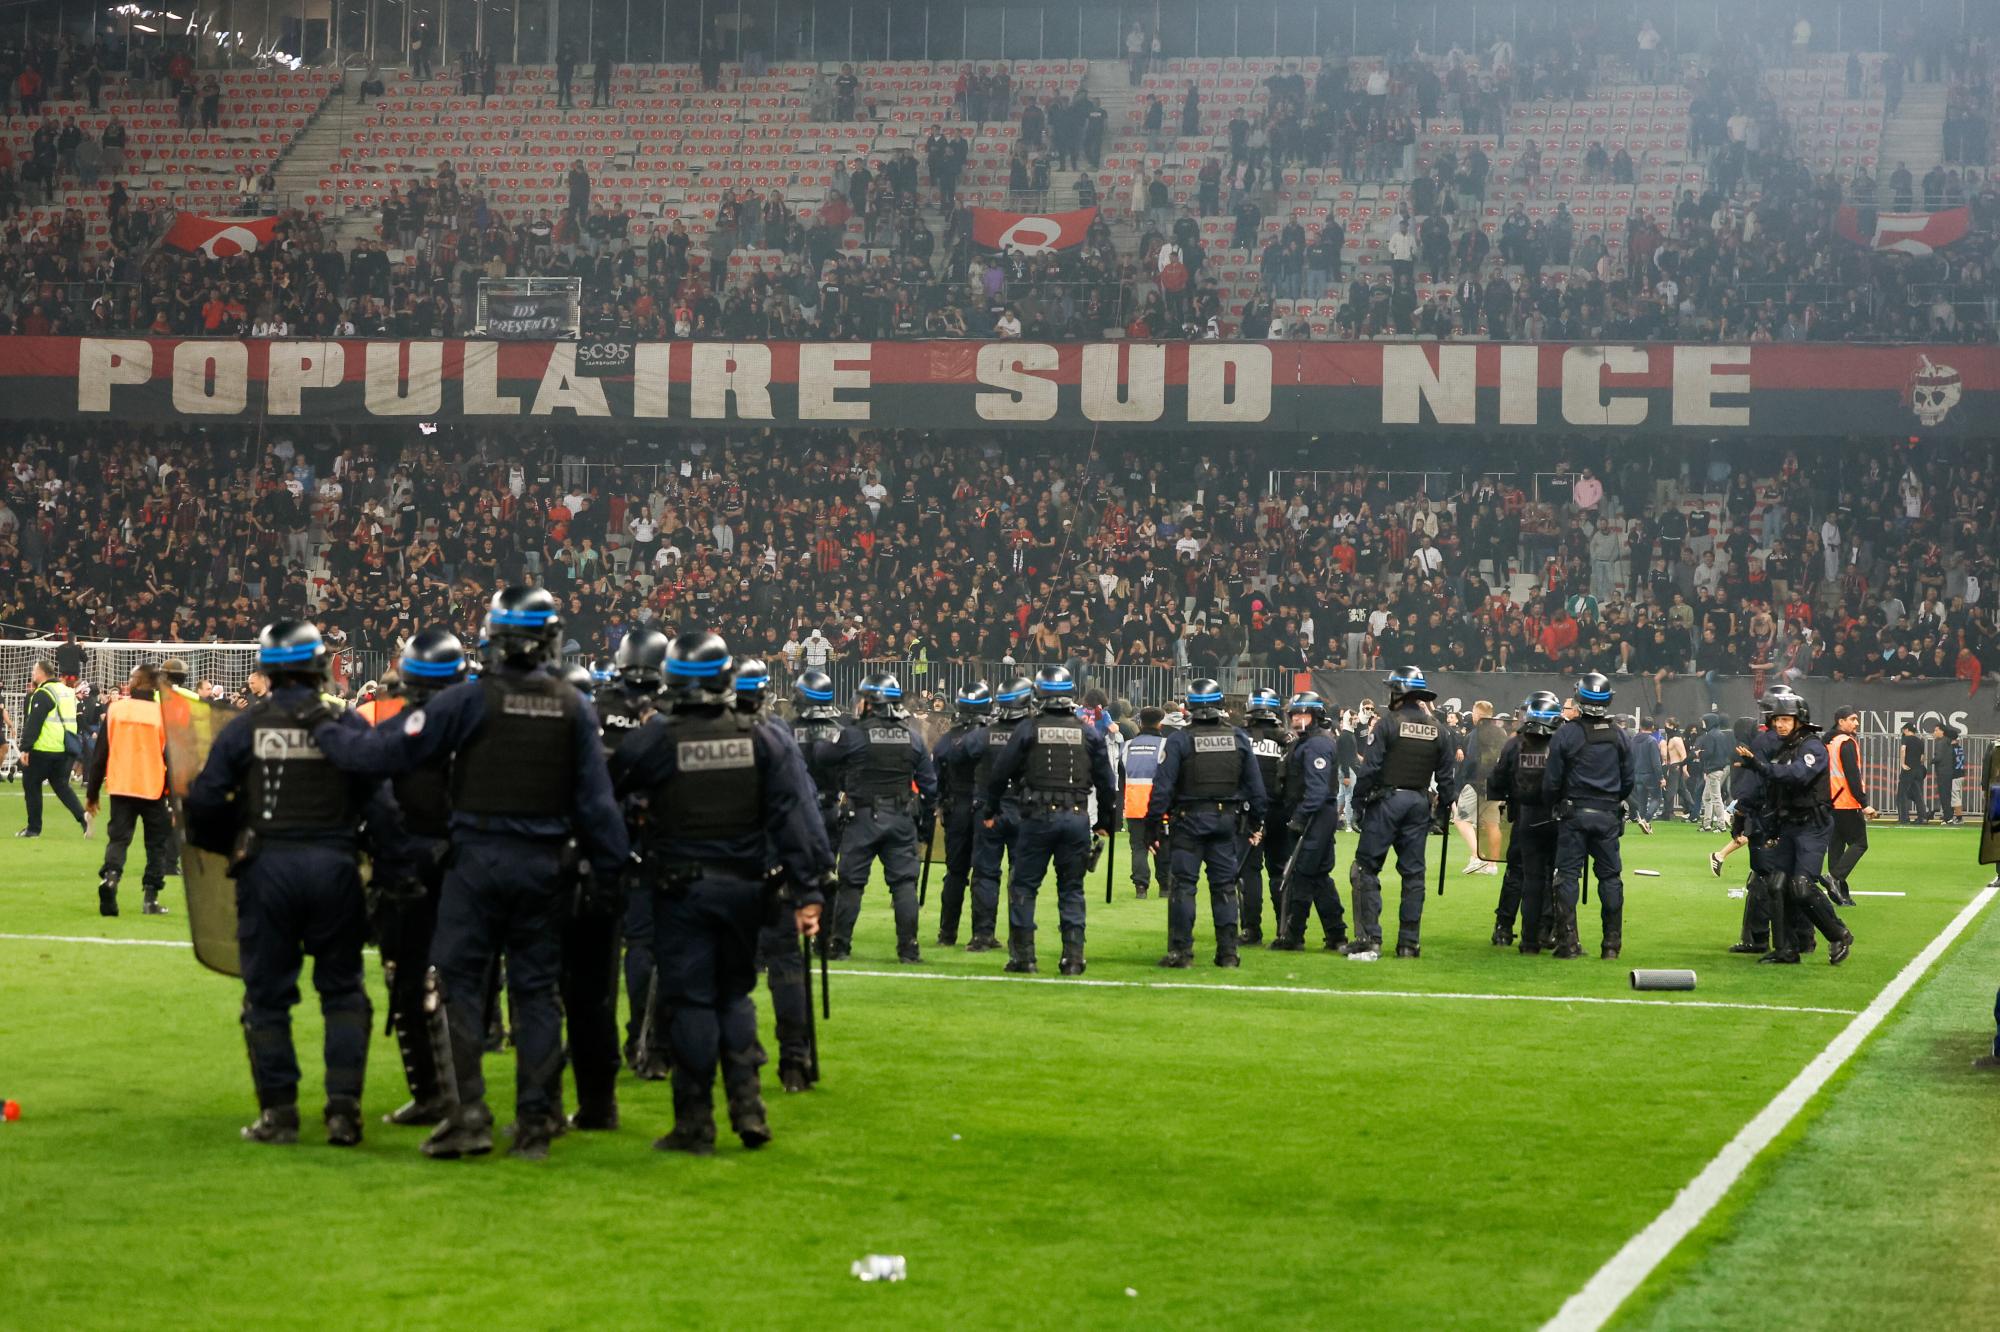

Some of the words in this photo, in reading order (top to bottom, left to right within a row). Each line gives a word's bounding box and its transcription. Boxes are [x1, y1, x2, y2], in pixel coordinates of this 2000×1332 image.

[578, 343, 631, 361] SC95
[78, 337, 872, 420] POPULAIRE
[975, 343, 1272, 423] SUD
[1382, 345, 1751, 426] NICE
[1402, 723, 1437, 736] POLICE
[1859, 711, 1969, 736] INEOS
[871, 729, 908, 739] POLICE
[1041, 728, 1080, 740] POLICE
[1197, 737, 1234, 747] POLICE
[682, 743, 750, 762] POLICE
